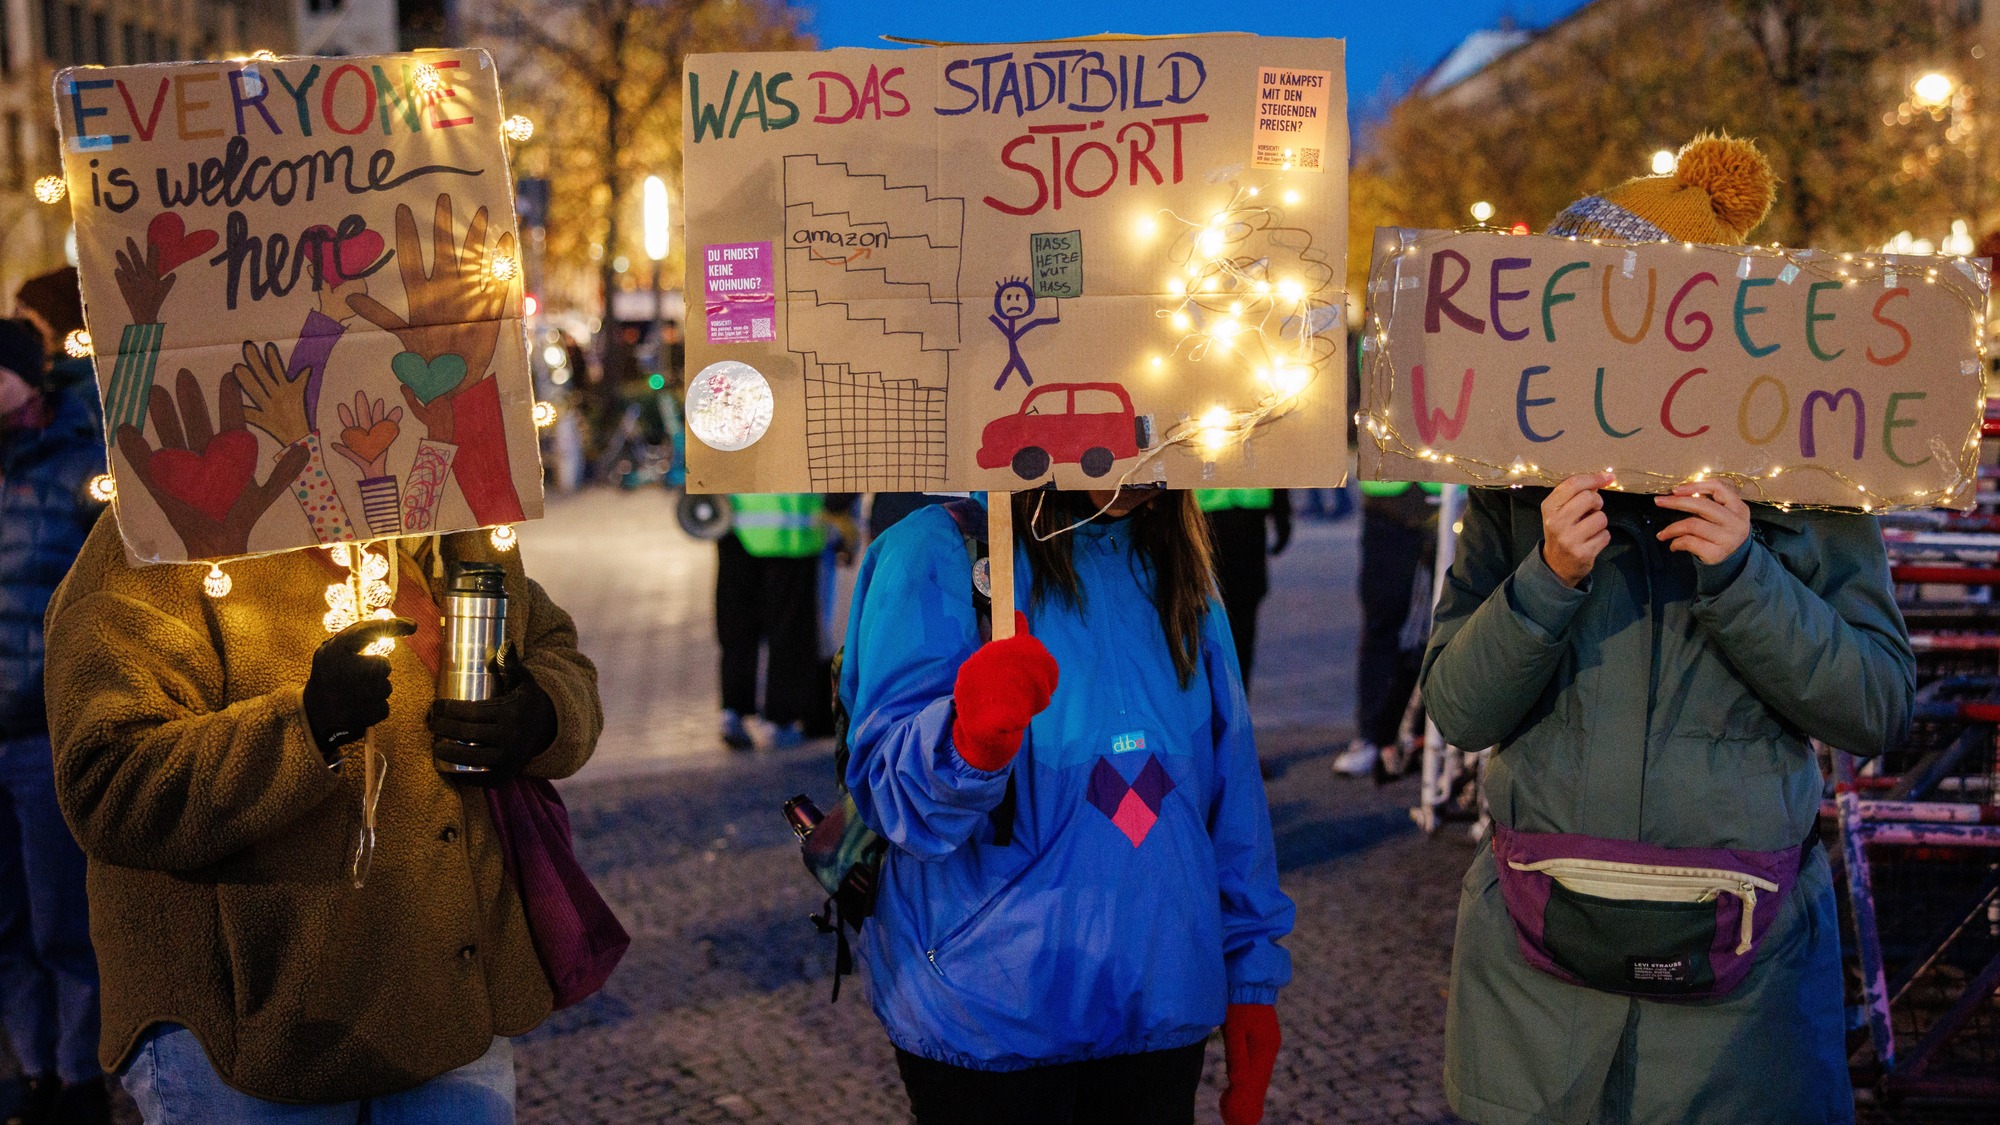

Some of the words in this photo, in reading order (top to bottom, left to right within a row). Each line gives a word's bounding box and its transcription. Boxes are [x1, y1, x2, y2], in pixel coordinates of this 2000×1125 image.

[1263, 73, 1277, 85] DU
[1279, 71, 1324, 88] KÄMPFST
[688, 69, 799, 143] WAS
[808, 64, 911, 124] DAS
[934, 48, 1207, 116] STADTBILD
[1262, 88, 1281, 100] MIT
[1283, 89, 1303, 102] DEN
[70, 60, 474, 149] EVERYONE
[1261, 103, 1317, 118] STEIGENDEN
[1259, 118, 1303, 133] PREISEN?
[983, 113, 1209, 215] STÖRT
[91, 159, 139, 213] is
[156, 135, 485, 207] welcome
[793, 229, 888, 249] amazon
[1035, 237, 1071, 253] HASS
[210, 210, 396, 310] here
[708, 249, 720, 262] DU
[723, 247, 759, 261] FINDEST
[1036, 251, 1079, 268] HETZE
[708, 264, 734, 277] KEINE
[1040, 266, 1068, 278] WUT
[709, 277, 762, 292] WOHNUNG?
[1040, 280, 1071, 293] HASS
[1424, 249, 1913, 366] REFUGEES
[1410, 364, 1931, 468] WELCOME
